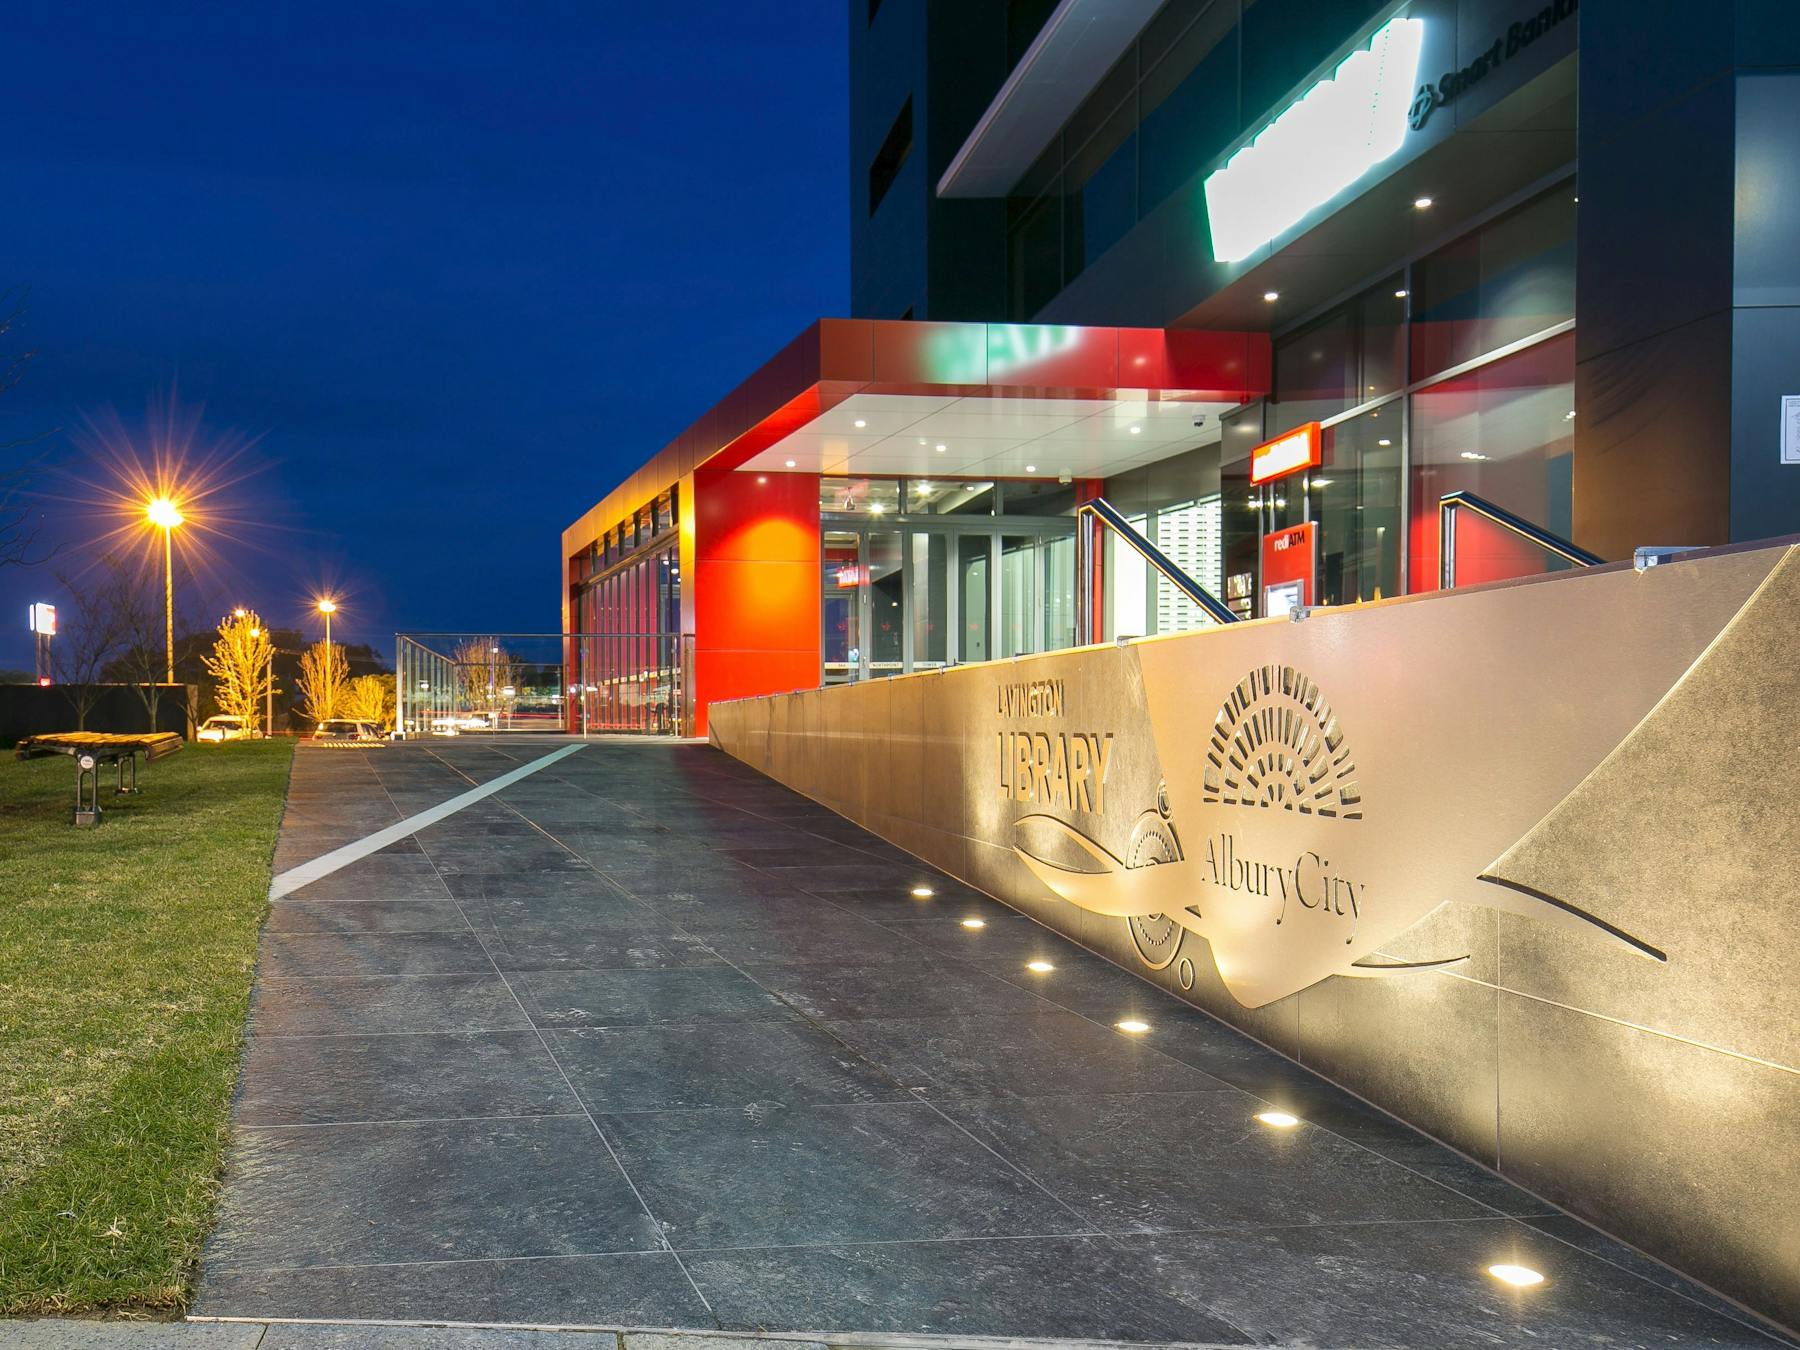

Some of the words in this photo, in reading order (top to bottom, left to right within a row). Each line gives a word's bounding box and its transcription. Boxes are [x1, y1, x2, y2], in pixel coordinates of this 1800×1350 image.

[1438, 37, 1503, 107] Smart
[997, 679, 1064, 718] LAVINGTON
[996, 731, 1114, 816] LIBRARY
[1201, 833, 1366, 945] AlburyCity
